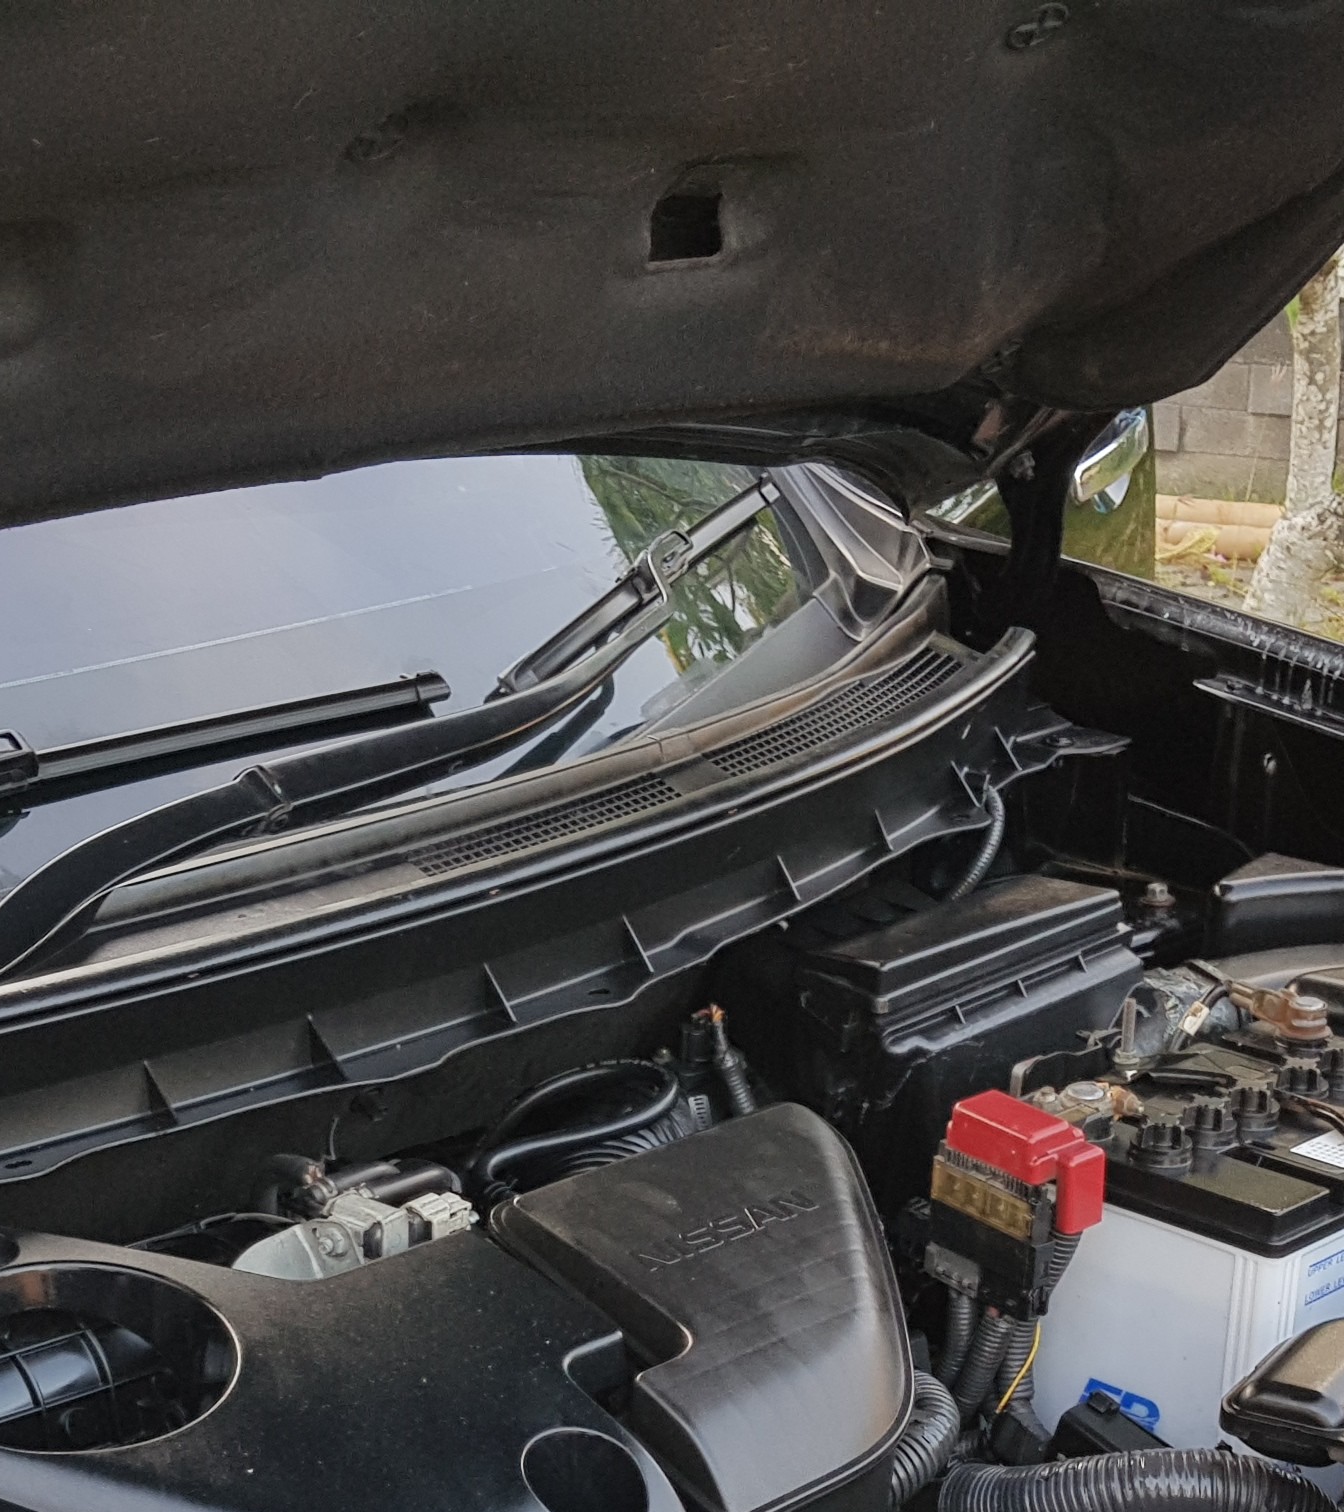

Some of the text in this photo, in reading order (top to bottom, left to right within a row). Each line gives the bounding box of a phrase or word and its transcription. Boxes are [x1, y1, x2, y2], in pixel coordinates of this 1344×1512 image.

[628, 1189, 820, 1273] NISSAN
[1308, 1258, 1333, 1277] UPPER
[1305, 1282, 1332, 1303] LOWER
